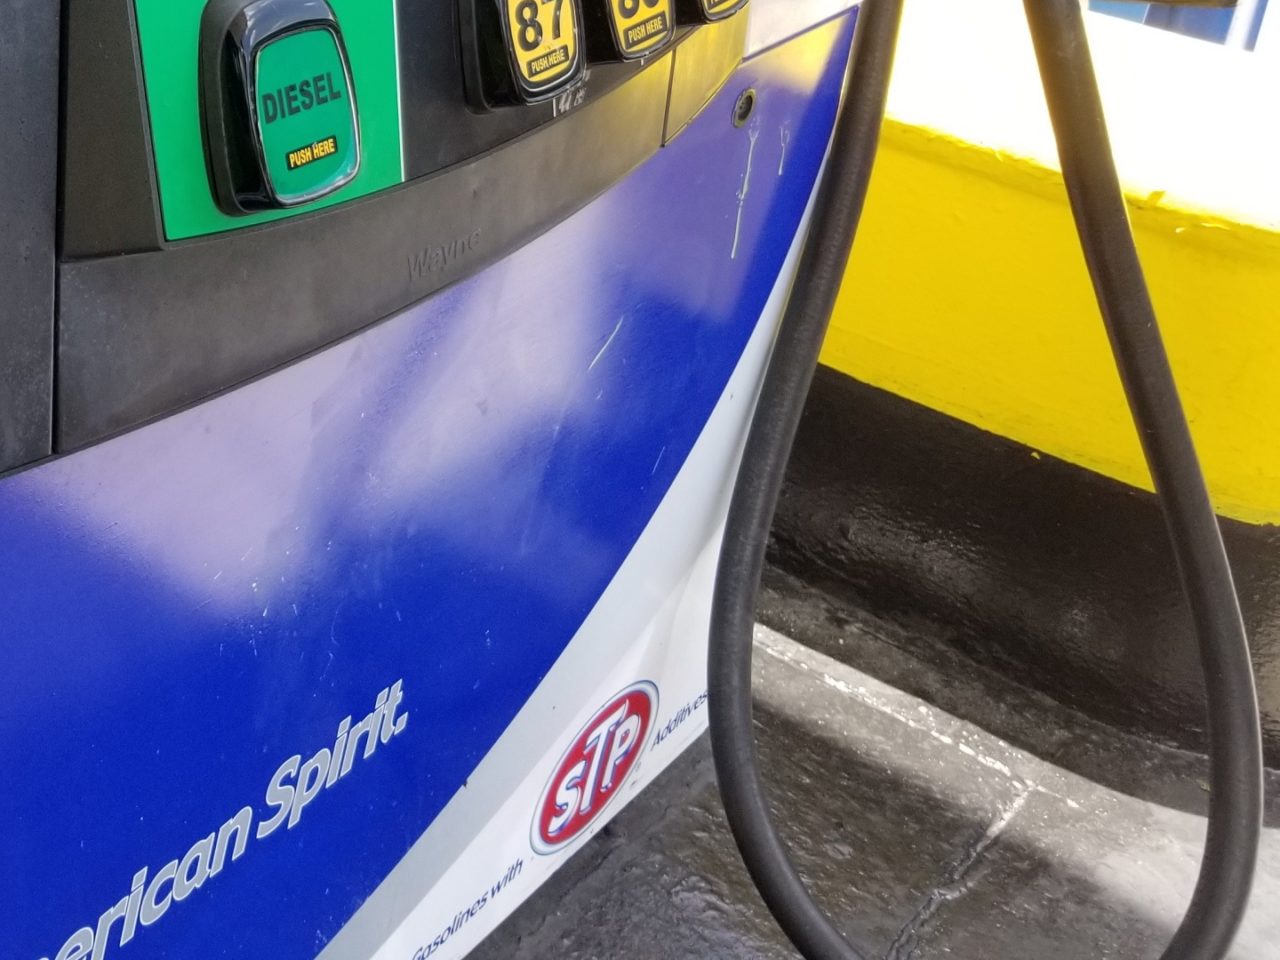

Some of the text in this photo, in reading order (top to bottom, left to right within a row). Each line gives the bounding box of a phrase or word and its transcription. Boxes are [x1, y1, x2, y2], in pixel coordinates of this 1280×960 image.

[628, 16, 663, 43] PUSH HERE
[531, 49, 565, 74] PUSH HERE
[261, 71, 341, 125] DIESEL
[289, 138, 335, 168] PUSH HERE
[38, 678, 409, 960] erican Spirit.
[412, 691, 709, 960] Gasolines with STP Additives
